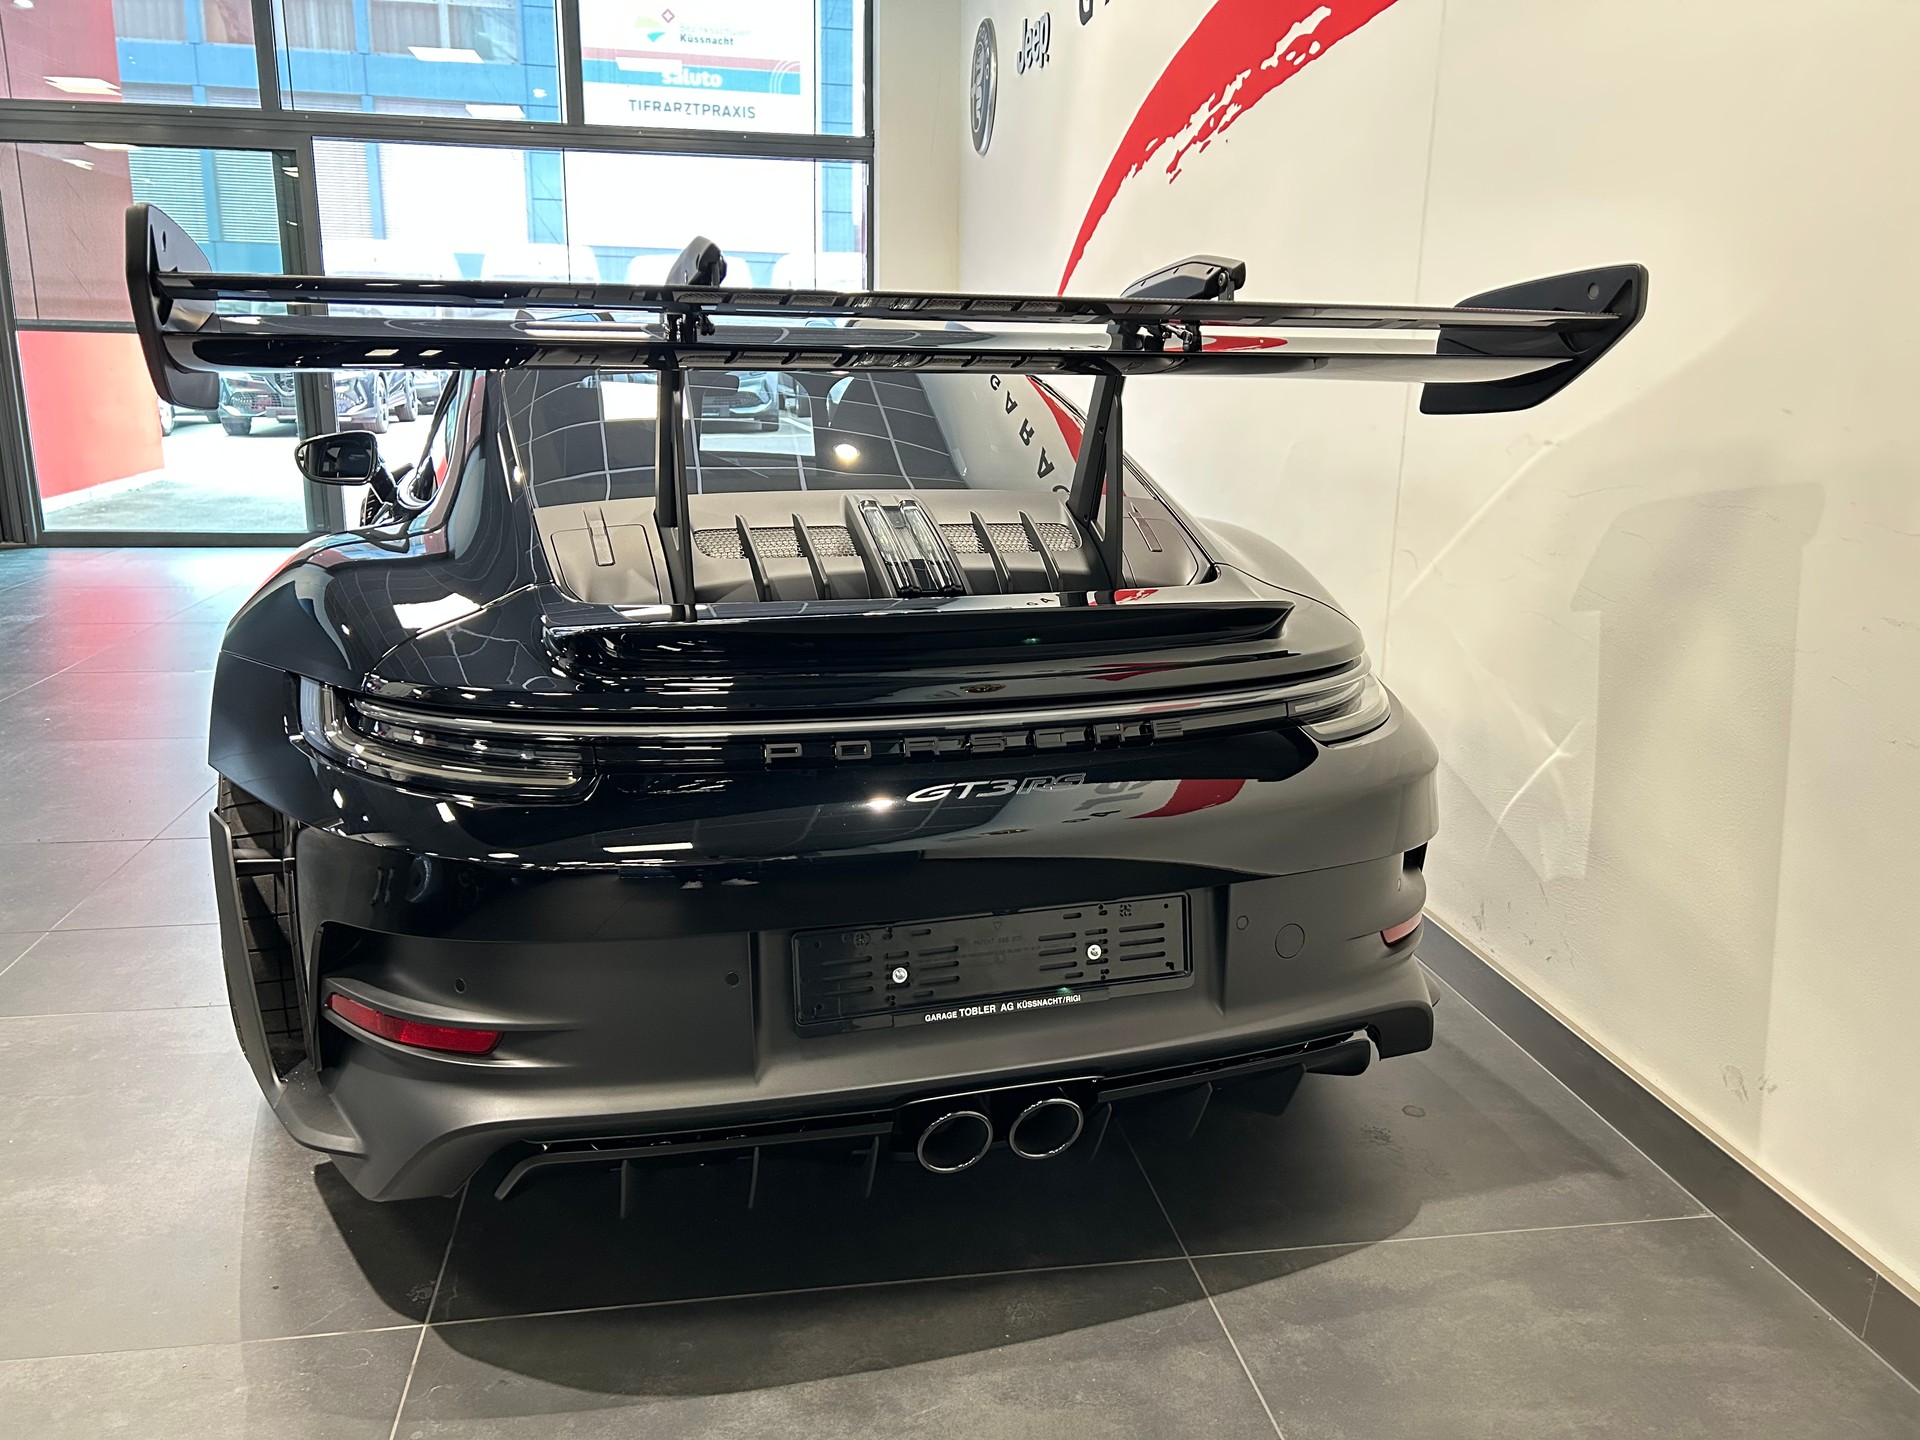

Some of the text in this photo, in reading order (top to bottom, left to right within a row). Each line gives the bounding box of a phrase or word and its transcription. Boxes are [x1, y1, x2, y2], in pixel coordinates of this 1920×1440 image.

[680, 33, 734, 45] Küssnacht
[1017, 11, 1051, 75] Jeep
[763, 719, 1185, 768] PORSCHE
[924, 994, 1081, 1022] GARAGE TOBLER AG KÜSSNACHT/RIGI
